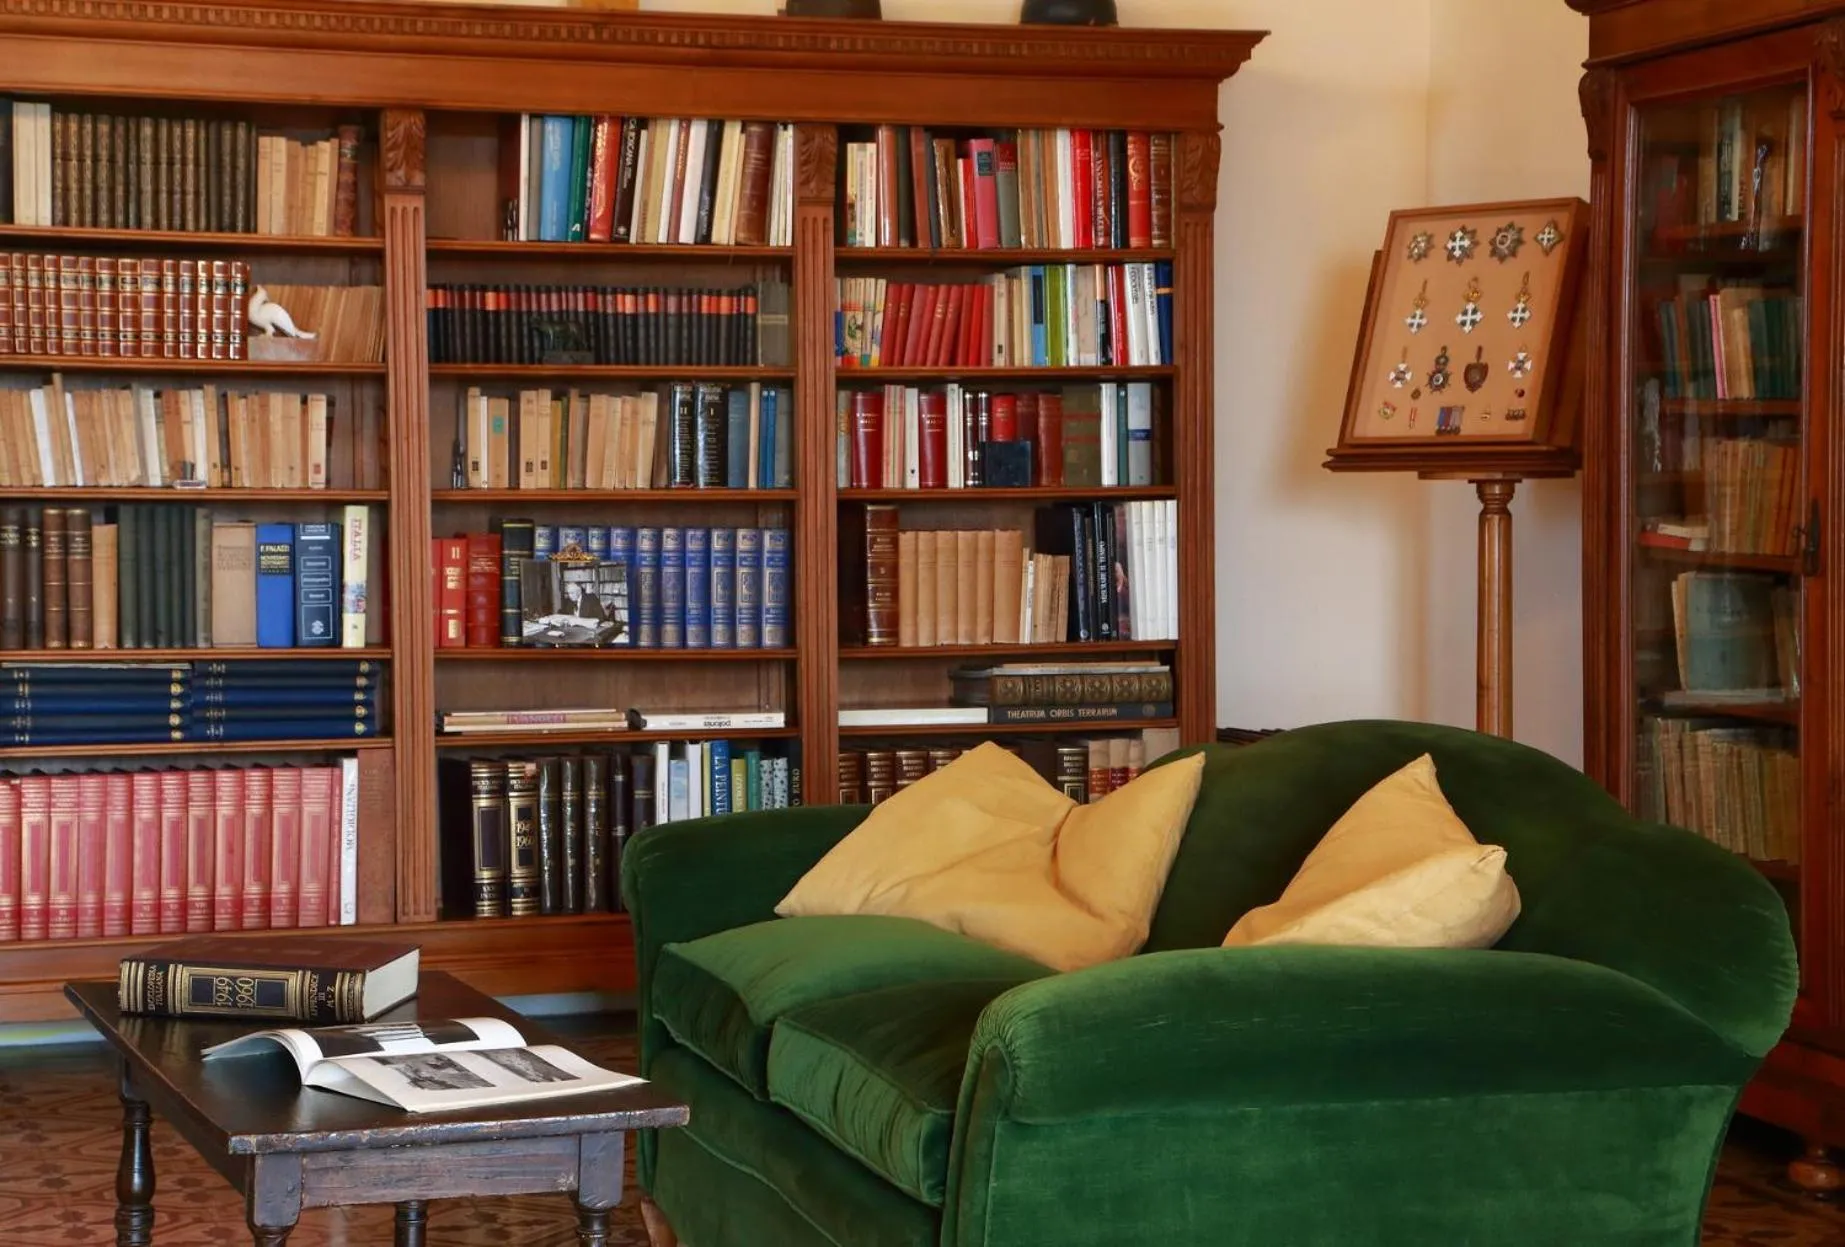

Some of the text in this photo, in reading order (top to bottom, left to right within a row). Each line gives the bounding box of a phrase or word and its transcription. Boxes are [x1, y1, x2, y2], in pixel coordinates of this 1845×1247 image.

[1049, 708, 1075, 718] ORBIS
[155, 971, 164, 1006] ITALIANA
[216, 977, 234, 1006] 1949
[236, 977, 255, 1008] 1960
[310, 973, 319, 1016] APPENDICE
